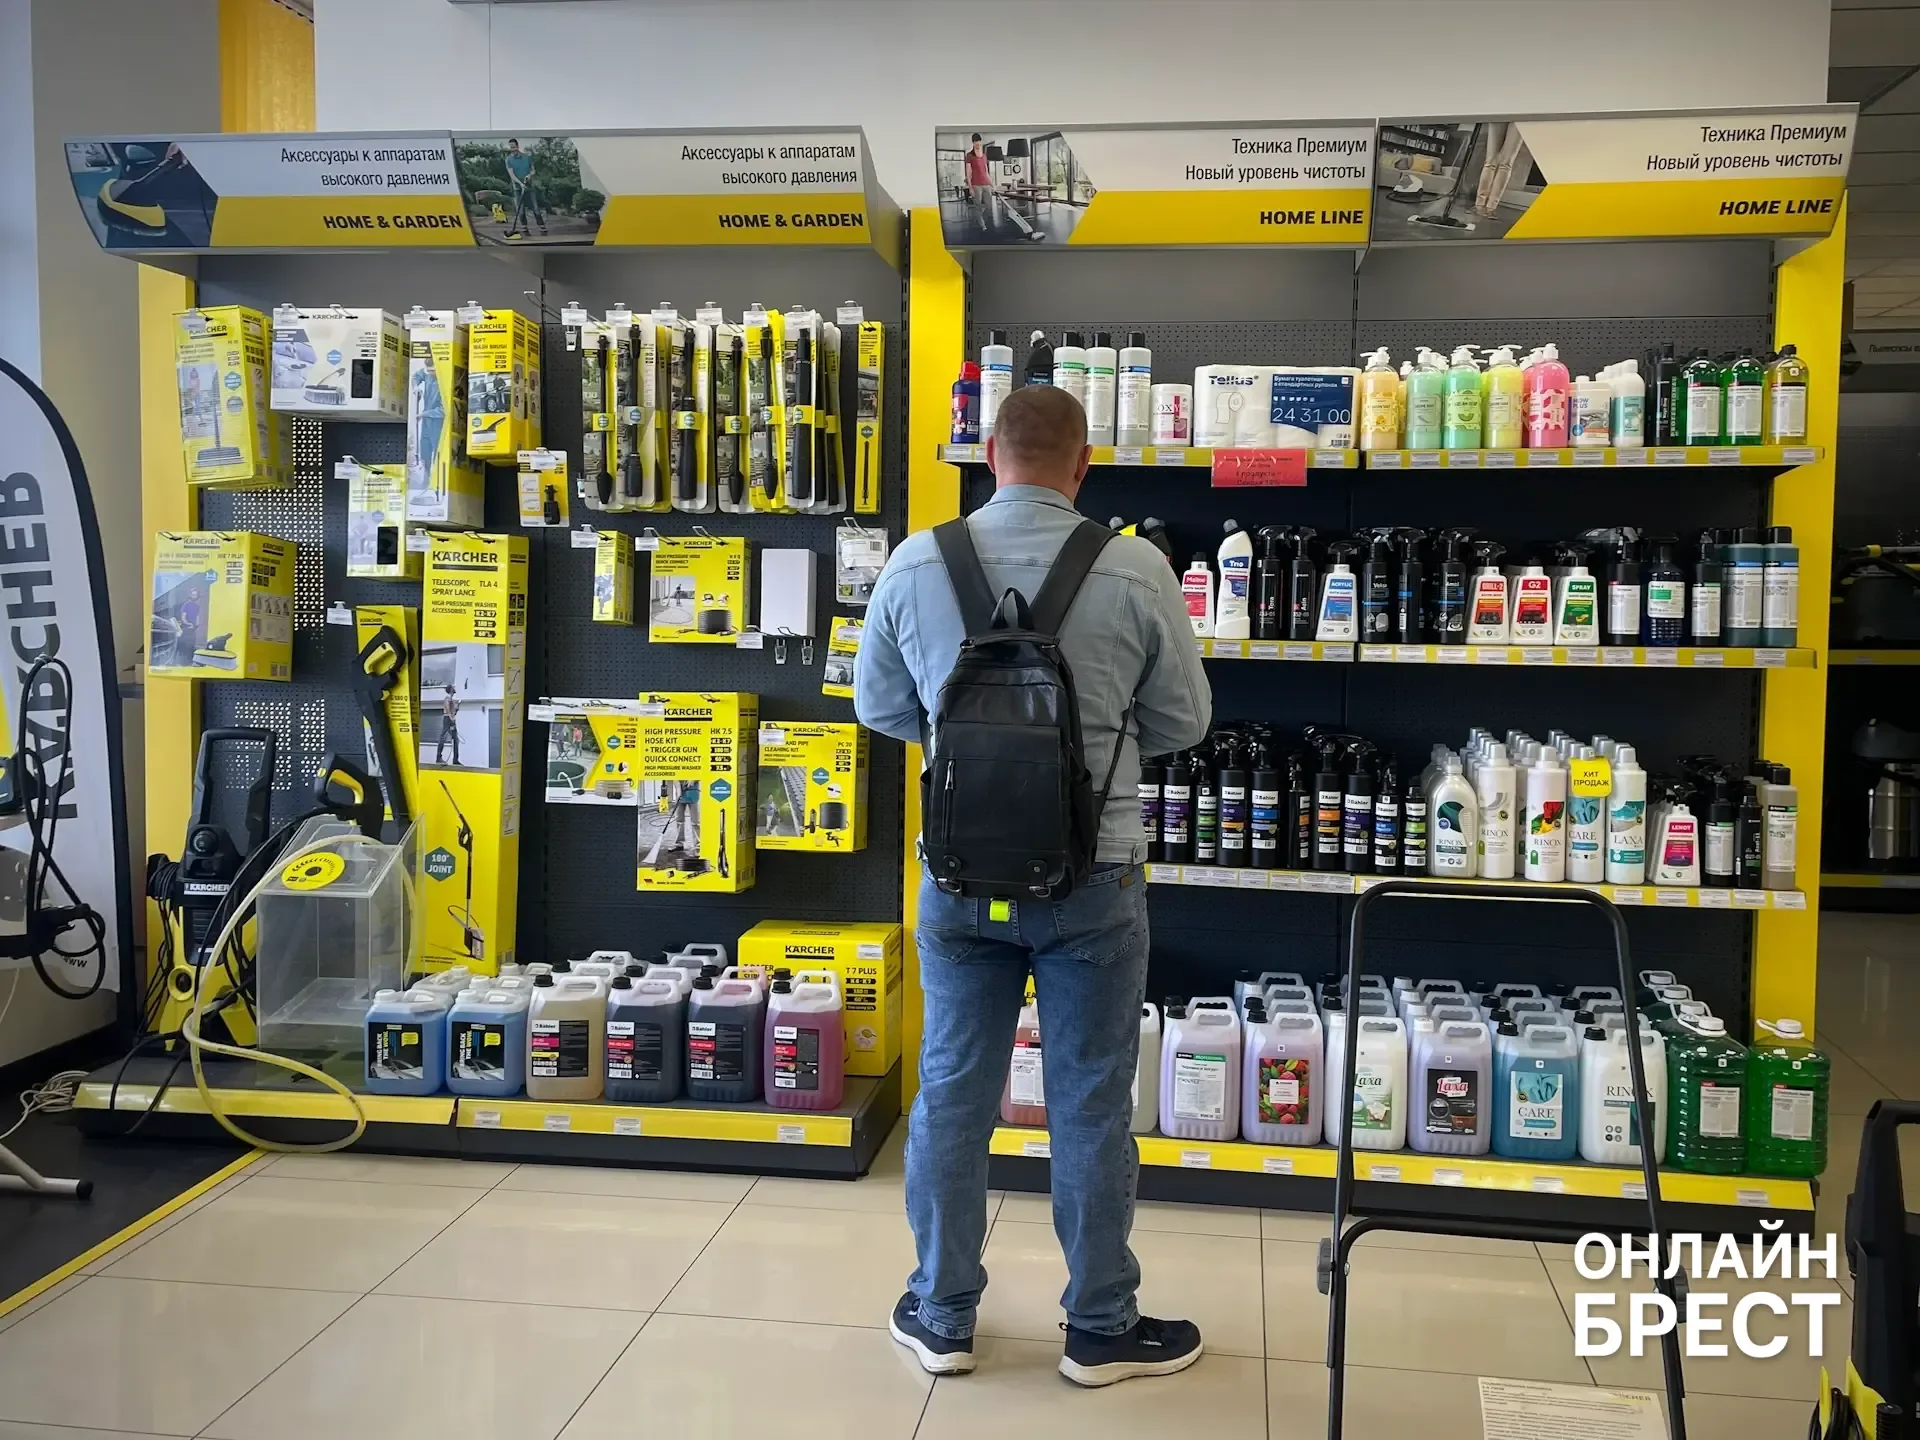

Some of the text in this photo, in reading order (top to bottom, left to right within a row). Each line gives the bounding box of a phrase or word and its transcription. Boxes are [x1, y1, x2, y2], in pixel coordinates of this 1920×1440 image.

[1701, 124, 1846, 143] Техника Премиум
[682, 146, 856, 162] Аксессуары к аппаратам
[1232, 138, 1367, 156] Техника Премиум
[280, 146, 446, 165] Аксессуары к аппаратам
[1647, 153, 1842, 172] Новый уровень чистоты
[322, 172, 450, 188] высокого давления
[722, 170, 857, 186] высокого давления
[1186, 164, 1366, 183] Новый уровень чистоты
[1719, 198, 1833, 216] HOME LINE
[323, 214, 462, 230] HOME & GARDEN
[718, 213, 864, 228] HOME & GARDEN
[1260, 210, 1364, 224] HOME LINE
[1157, 402, 1180, 414] OXY
[1272, 408, 1350, 423] 24 31 00
[432, 551, 498, 563] KÄRCHER
[1574, 779, 1609, 787] ПРОДАЖ
[1481, 829, 1508, 837] RINOX
[1569, 831, 1596, 840] CARE
[1614, 835, 1643, 844] LAXA
[428, 865, 452, 873] JOINT
[189, 883, 230, 891] KÄRCHER
[785, 945, 834, 954] KÄRCHER
[1354, 1073, 1382, 1087] Laxa
[1438, 1079, 1467, 1093] Laxa
[1607, 1086, 1654, 1098] RINX
[1518, 1107, 1554, 1118] CARE
